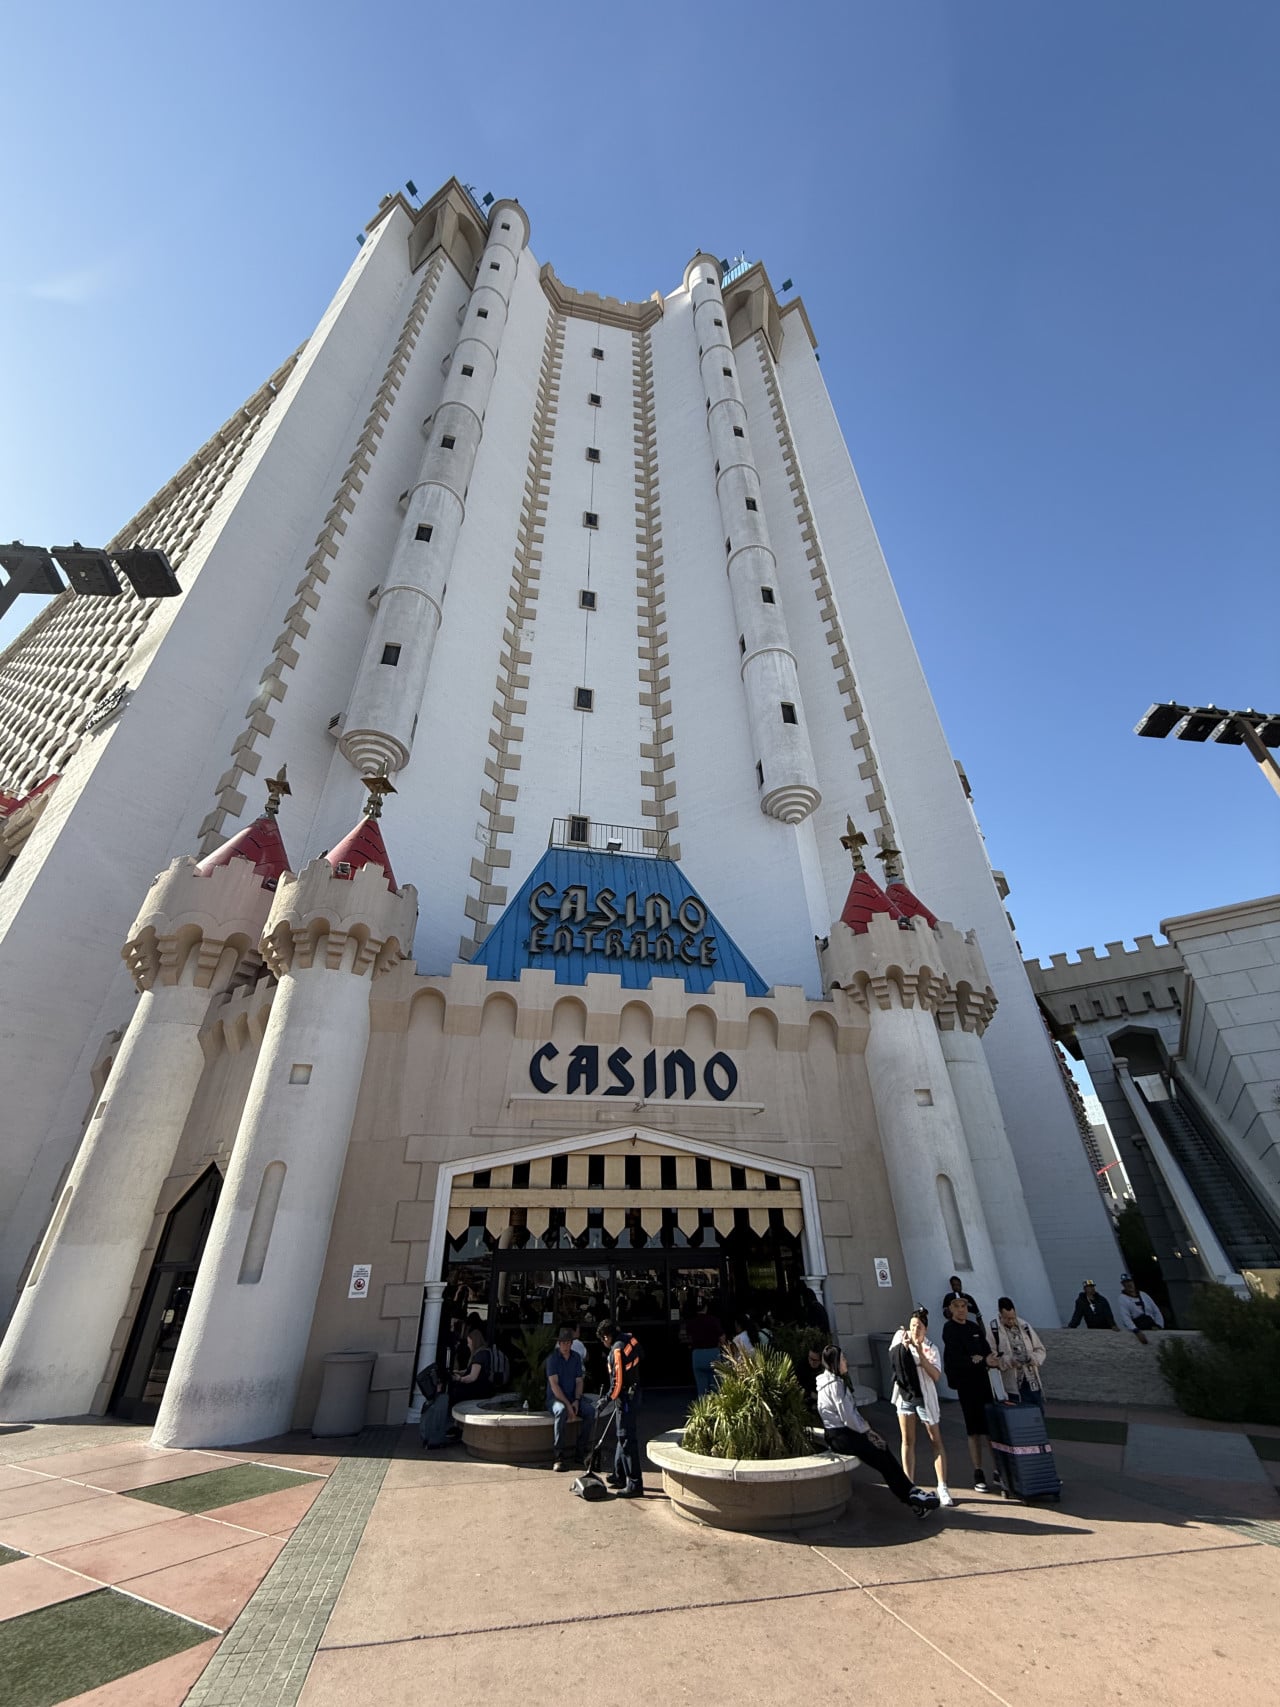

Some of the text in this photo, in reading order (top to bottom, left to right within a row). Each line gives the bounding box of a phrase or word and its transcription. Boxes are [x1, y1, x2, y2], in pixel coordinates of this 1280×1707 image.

[528, 881, 708, 935] CASINO
[529, 922, 717, 967] ENTRANCE
[529, 1042, 738, 1102] CASINO
